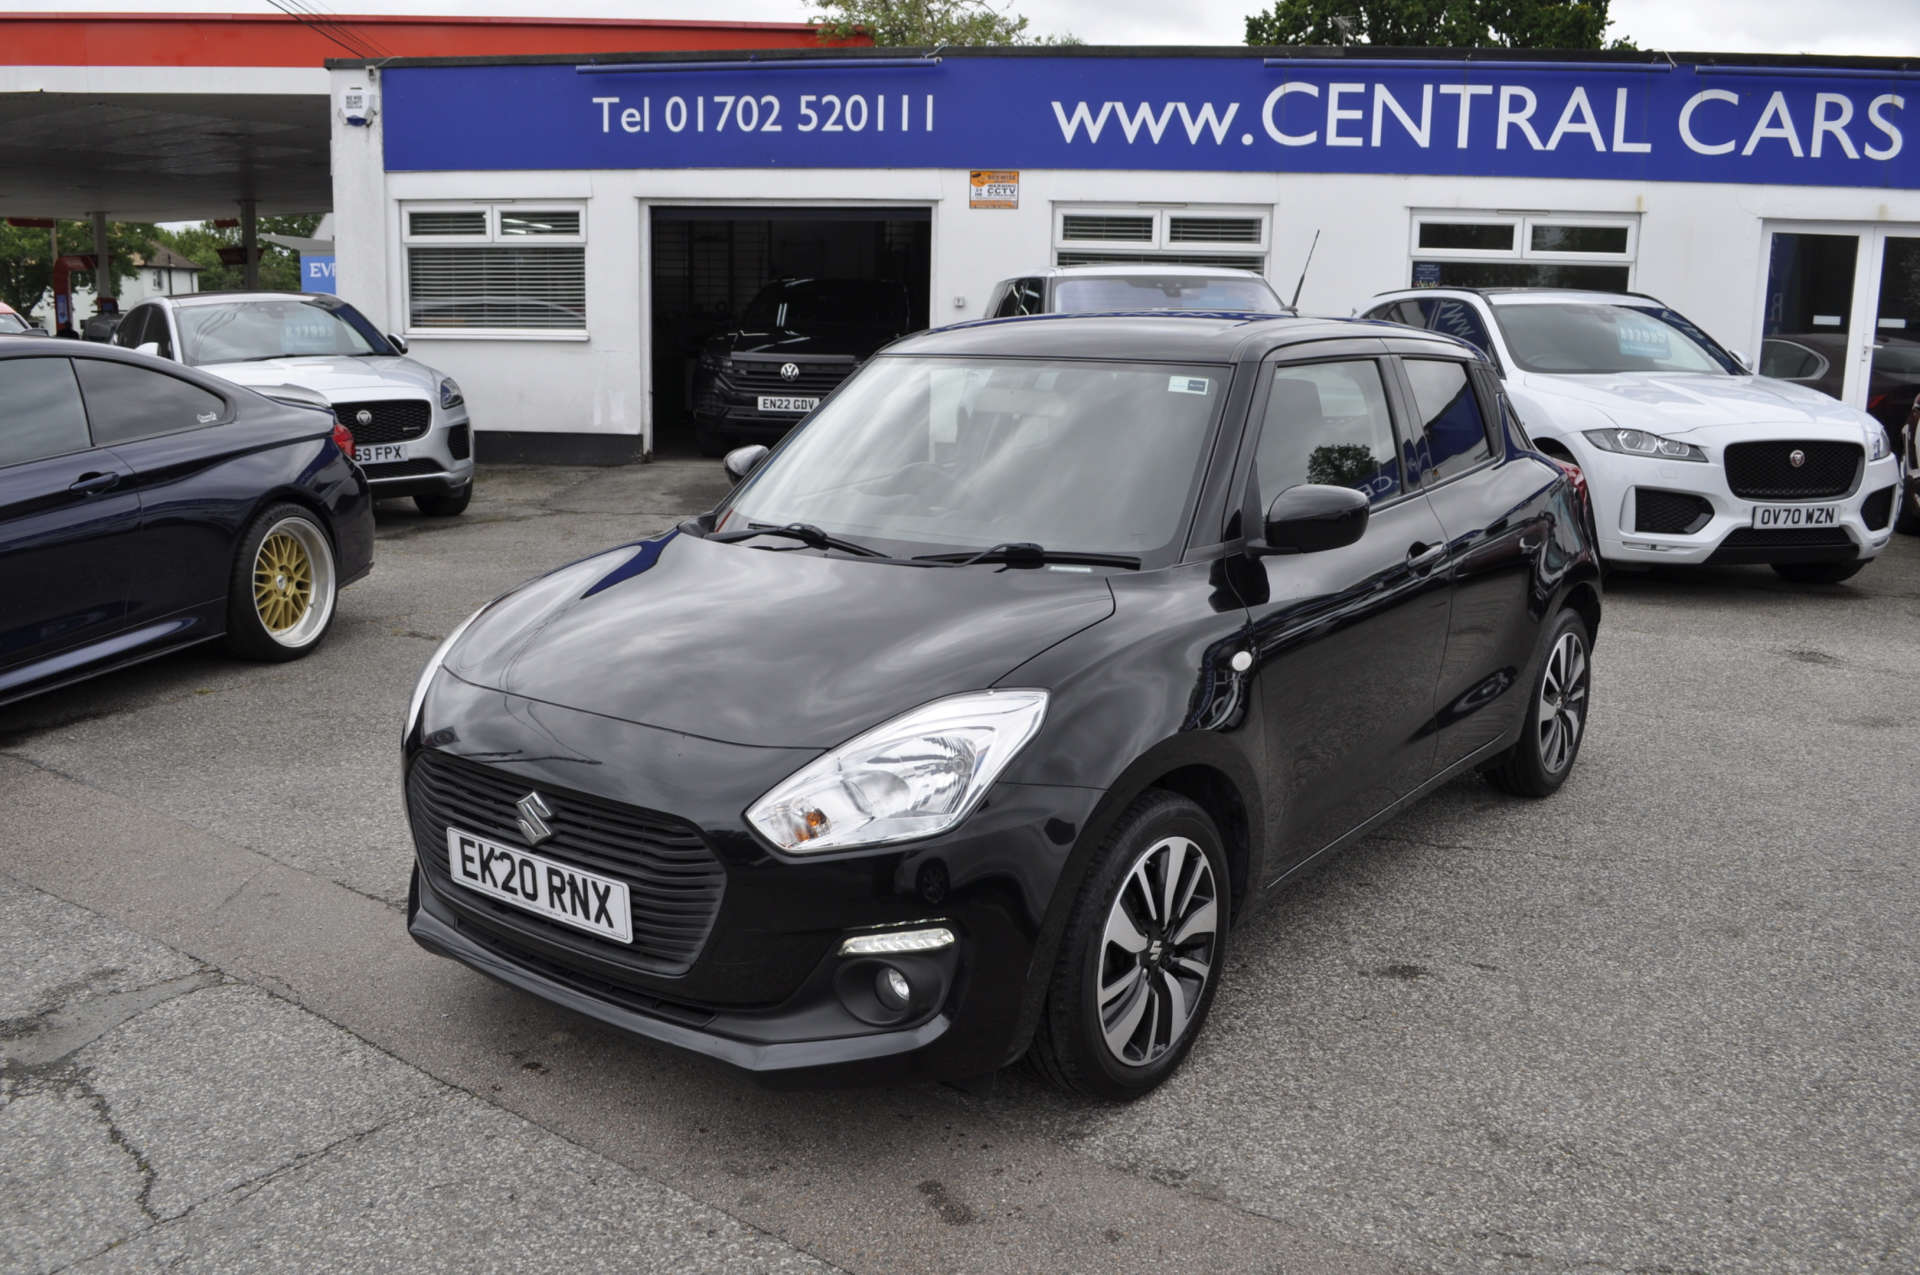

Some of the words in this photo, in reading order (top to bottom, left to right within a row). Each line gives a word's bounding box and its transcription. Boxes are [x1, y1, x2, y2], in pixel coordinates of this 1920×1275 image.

[592, 96, 650, 133] Tel
[665, 95, 783, 132] 01702
[797, 94, 935, 132] 520111
[1678, 88, 1906, 161] CARS
[762, 398, 791, 410] EN22
[793, 399, 815, 410] GDV
[375, 446, 403, 460] FPX
[1760, 508, 1802, 525] OV70
[1805, 507, 1835, 524] WZN
[458, 836, 539, 902] EK20
[546, 866, 615, 930] RNX
